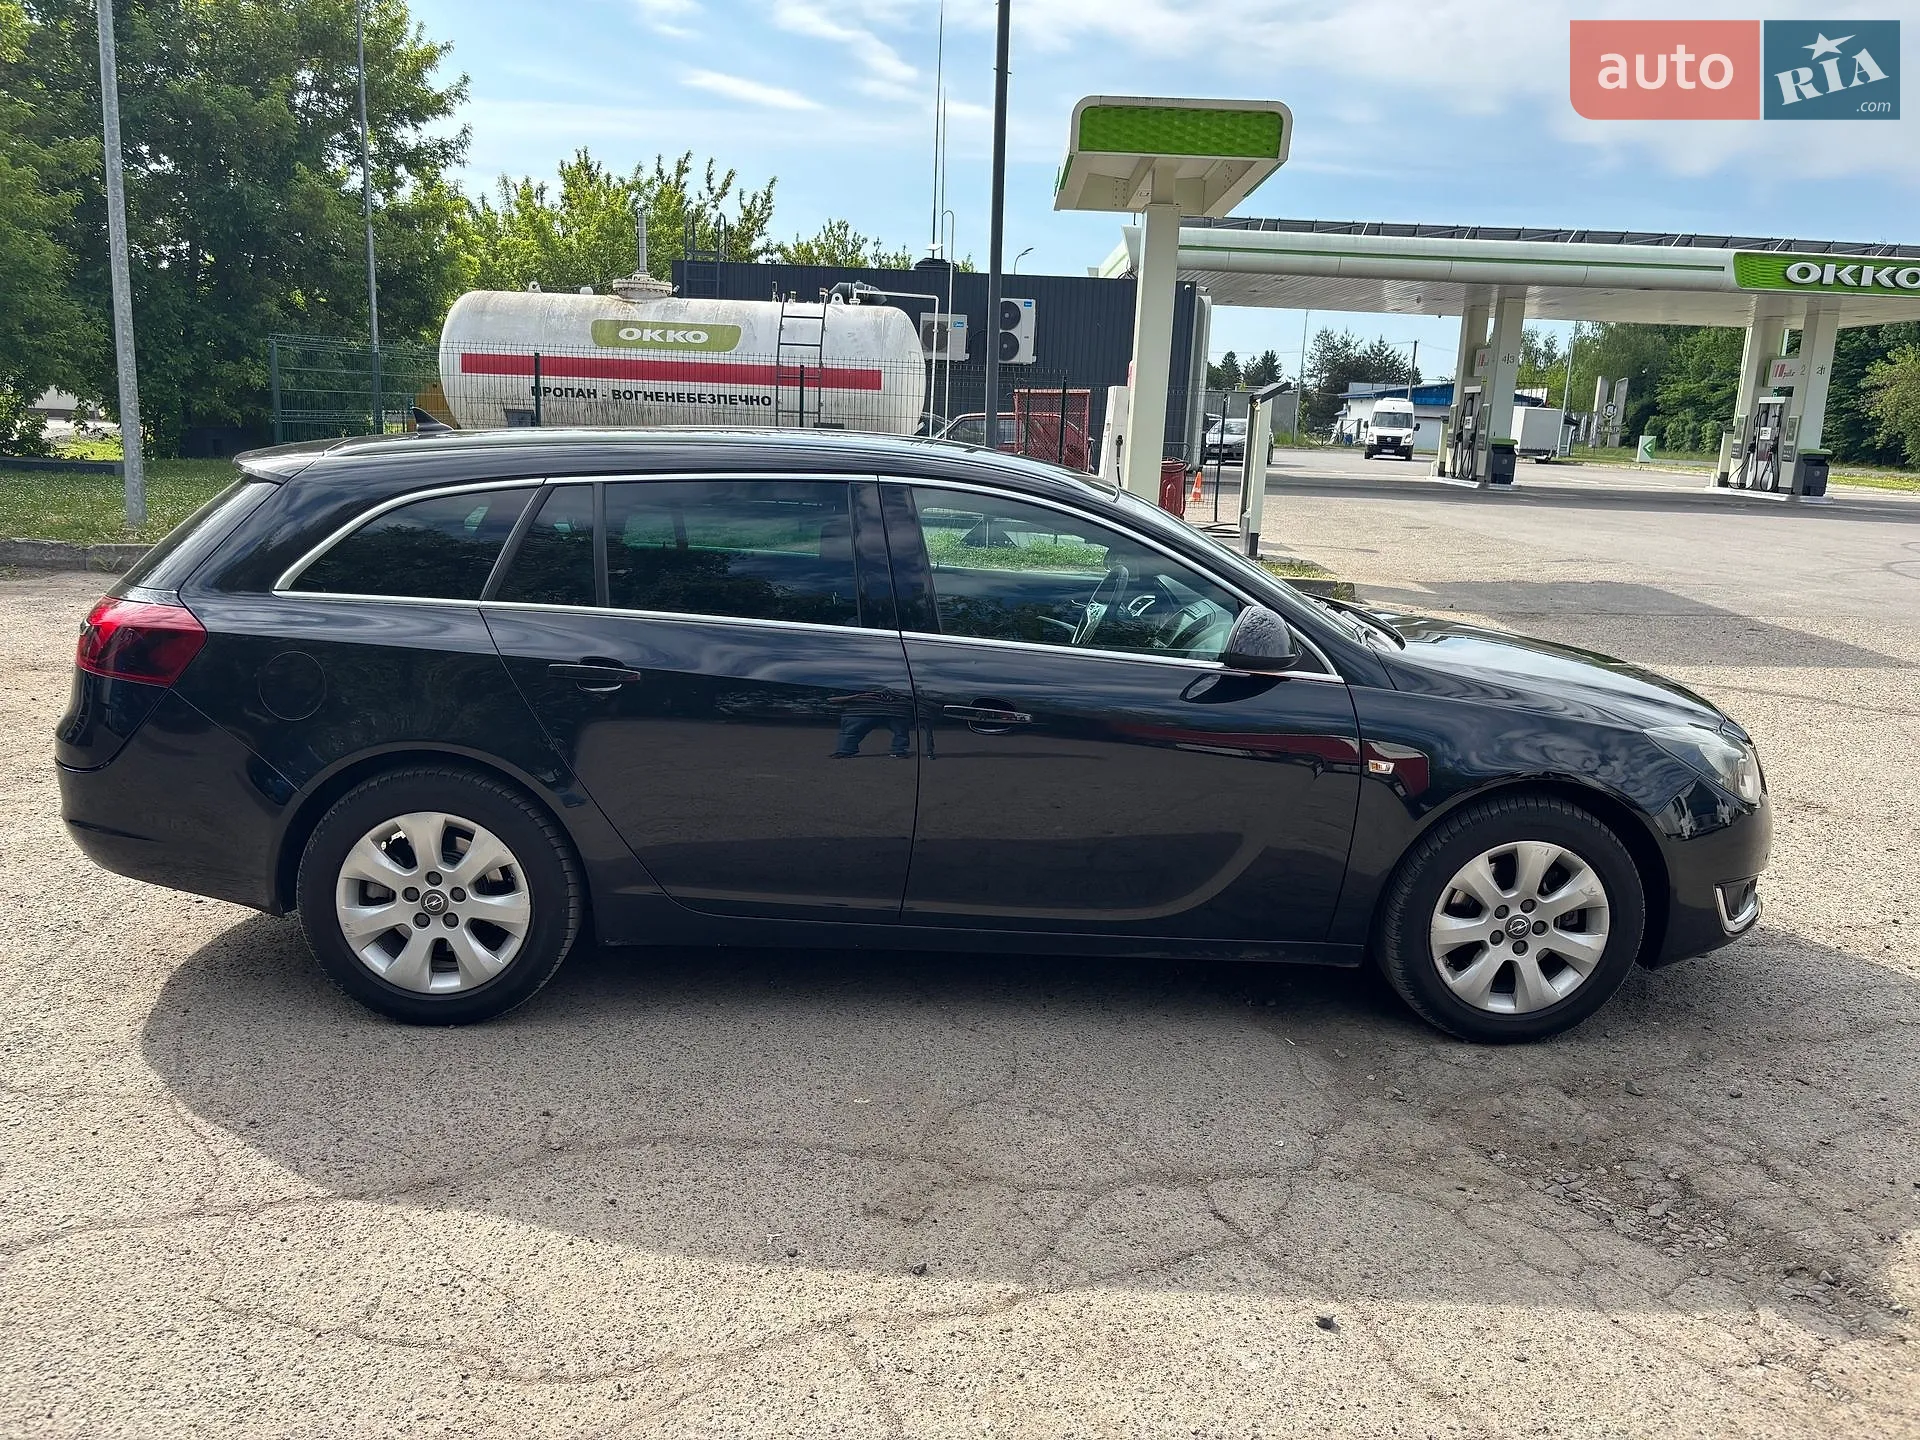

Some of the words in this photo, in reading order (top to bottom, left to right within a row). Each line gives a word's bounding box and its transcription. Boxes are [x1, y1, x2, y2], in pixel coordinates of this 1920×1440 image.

[1786, 262, 1920, 289] OKKO
[618, 327, 709, 344] OKKO
[612, 389, 772, 406] ВОГНЕНЕБЕЗПЕЧНО
